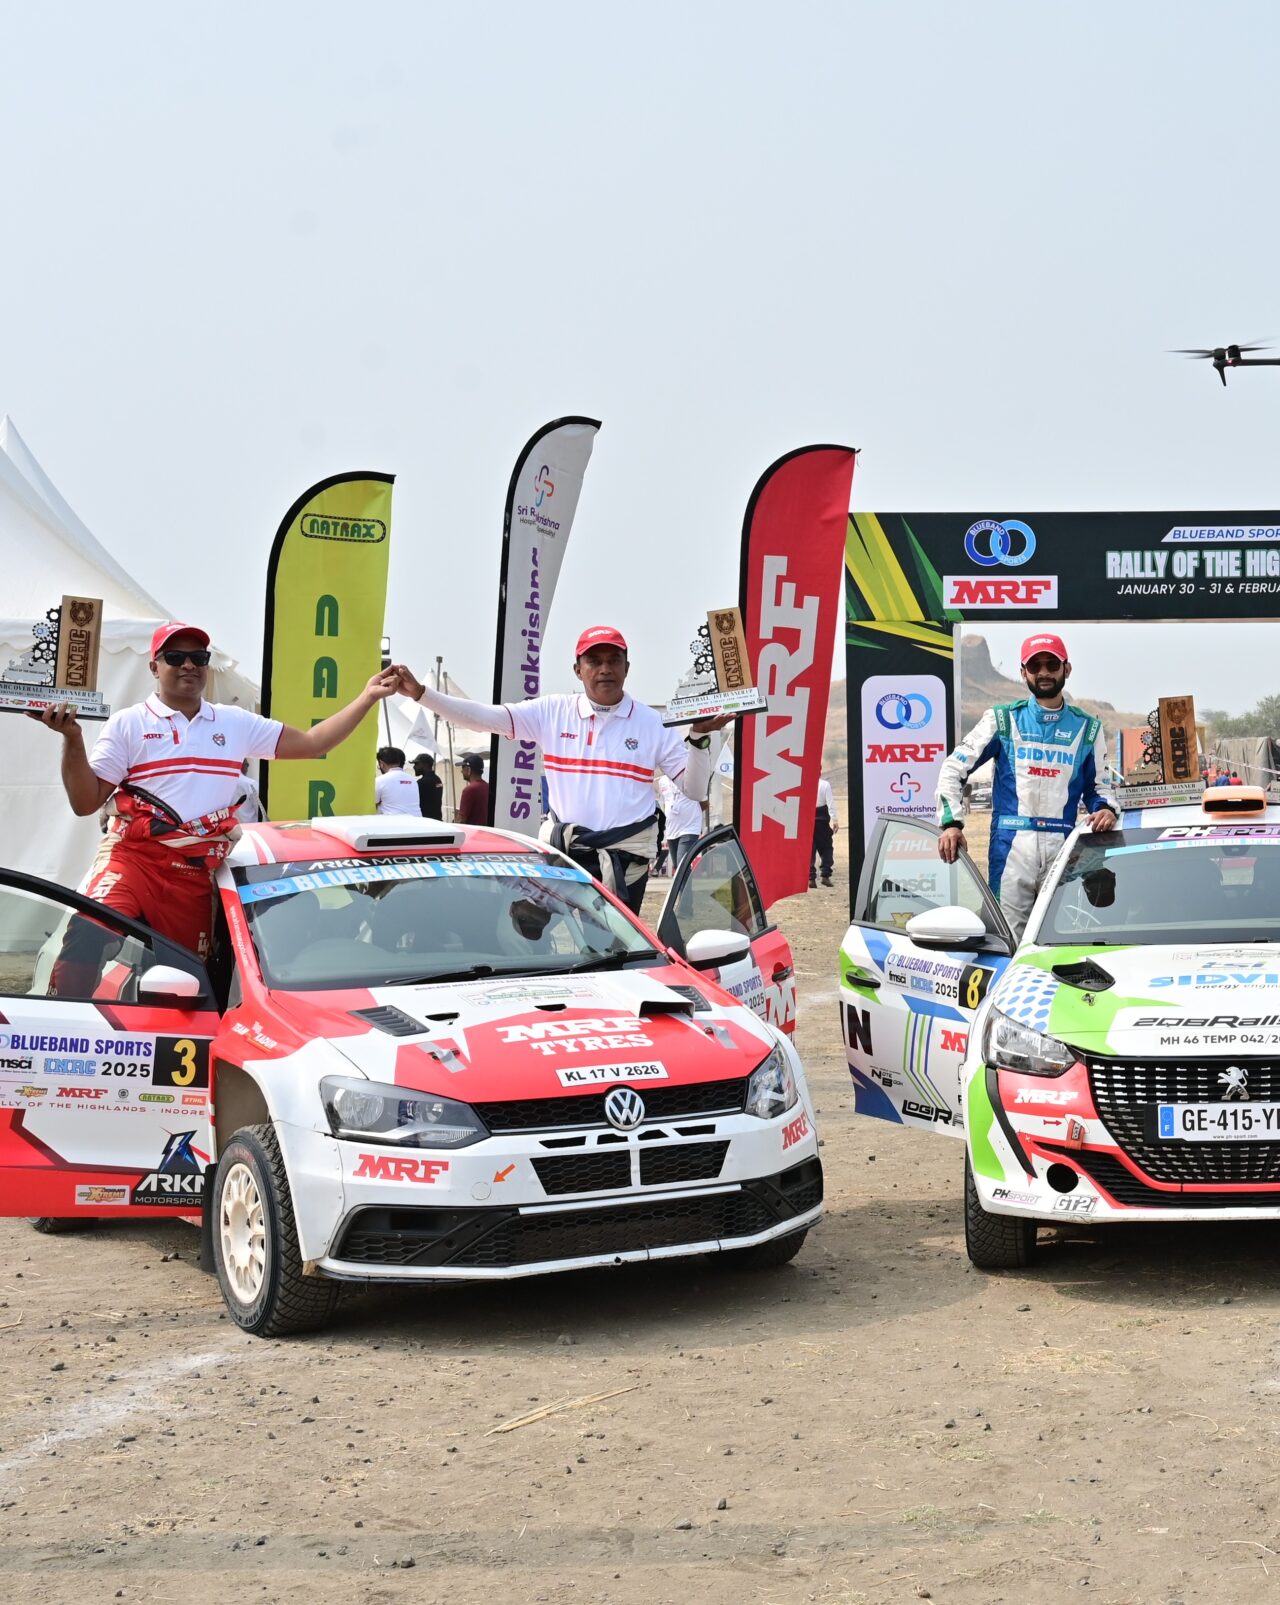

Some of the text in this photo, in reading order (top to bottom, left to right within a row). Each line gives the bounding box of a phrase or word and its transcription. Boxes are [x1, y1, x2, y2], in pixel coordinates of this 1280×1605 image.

[309, 518, 376, 538] NATRAX
[969, 521, 1005, 536] BLUEBAND
[1172, 529, 1245, 540] BLUEBAND
[1000, 554, 1027, 565] SPORTS
[1106, 551, 1168, 579] RALLY
[1172, 550, 1200, 578] OF
[1202, 550, 1241, 578] THE
[950, 580, 1051, 604] MRF
[1117, 584, 1176, 595] JANUARY
[1179, 584, 1195, 594] 30
[1209, 583, 1222, 594] 31
[1225, 583, 1235, 594] &
[752, 555, 820, 839] MRF
[698, 706, 721, 715] MRF
[866, 744, 944, 763] MRF
[1017, 747, 1073, 766] SIDVIN
[1027, 766, 1060, 778] MRF
[510, 776, 533, 819] Sri
[888, 805, 937, 813] Ramakrishna
[308, 854, 545, 871] ARKA MOTORSPORTS
[293, 862, 542, 891] BLUEBAND SPORTS
[897, 955, 962, 981] BLUEBAND SPORTS
[743, 976, 762, 993] SPORTS
[888, 970, 958, 999] fmsci 2025
[966, 968, 984, 1009] 8
[749, 993, 764, 1009] 2025
[496, 1016, 654, 1043] MRF
[10, 1034, 153, 1057] BLUEBAND SPORTS
[531, 1033, 654, 1055] TYRES
[1160, 1036, 1180, 1045] MH
[1184, 1035, 1199, 1045] 46
[1203, 1035, 1236, 1044] TEMP
[44, 1057, 150, 1078] INRC 2025
[171, 1039, 197, 1086] 3
[565, 1064, 660, 1083] KL 17 V 2626
[56, 1087, 108, 1099] MRF
[1014, 1088, 1079, 1105] MRF
[78, 1104, 146, 1112] HIGHLANDS
[782, 1111, 809, 1150] MRF
[353, 1154, 449, 1184] MRF
[135, 1173, 204, 1193] ARK
[135, 1196, 202, 1205] MOTORSPOR
